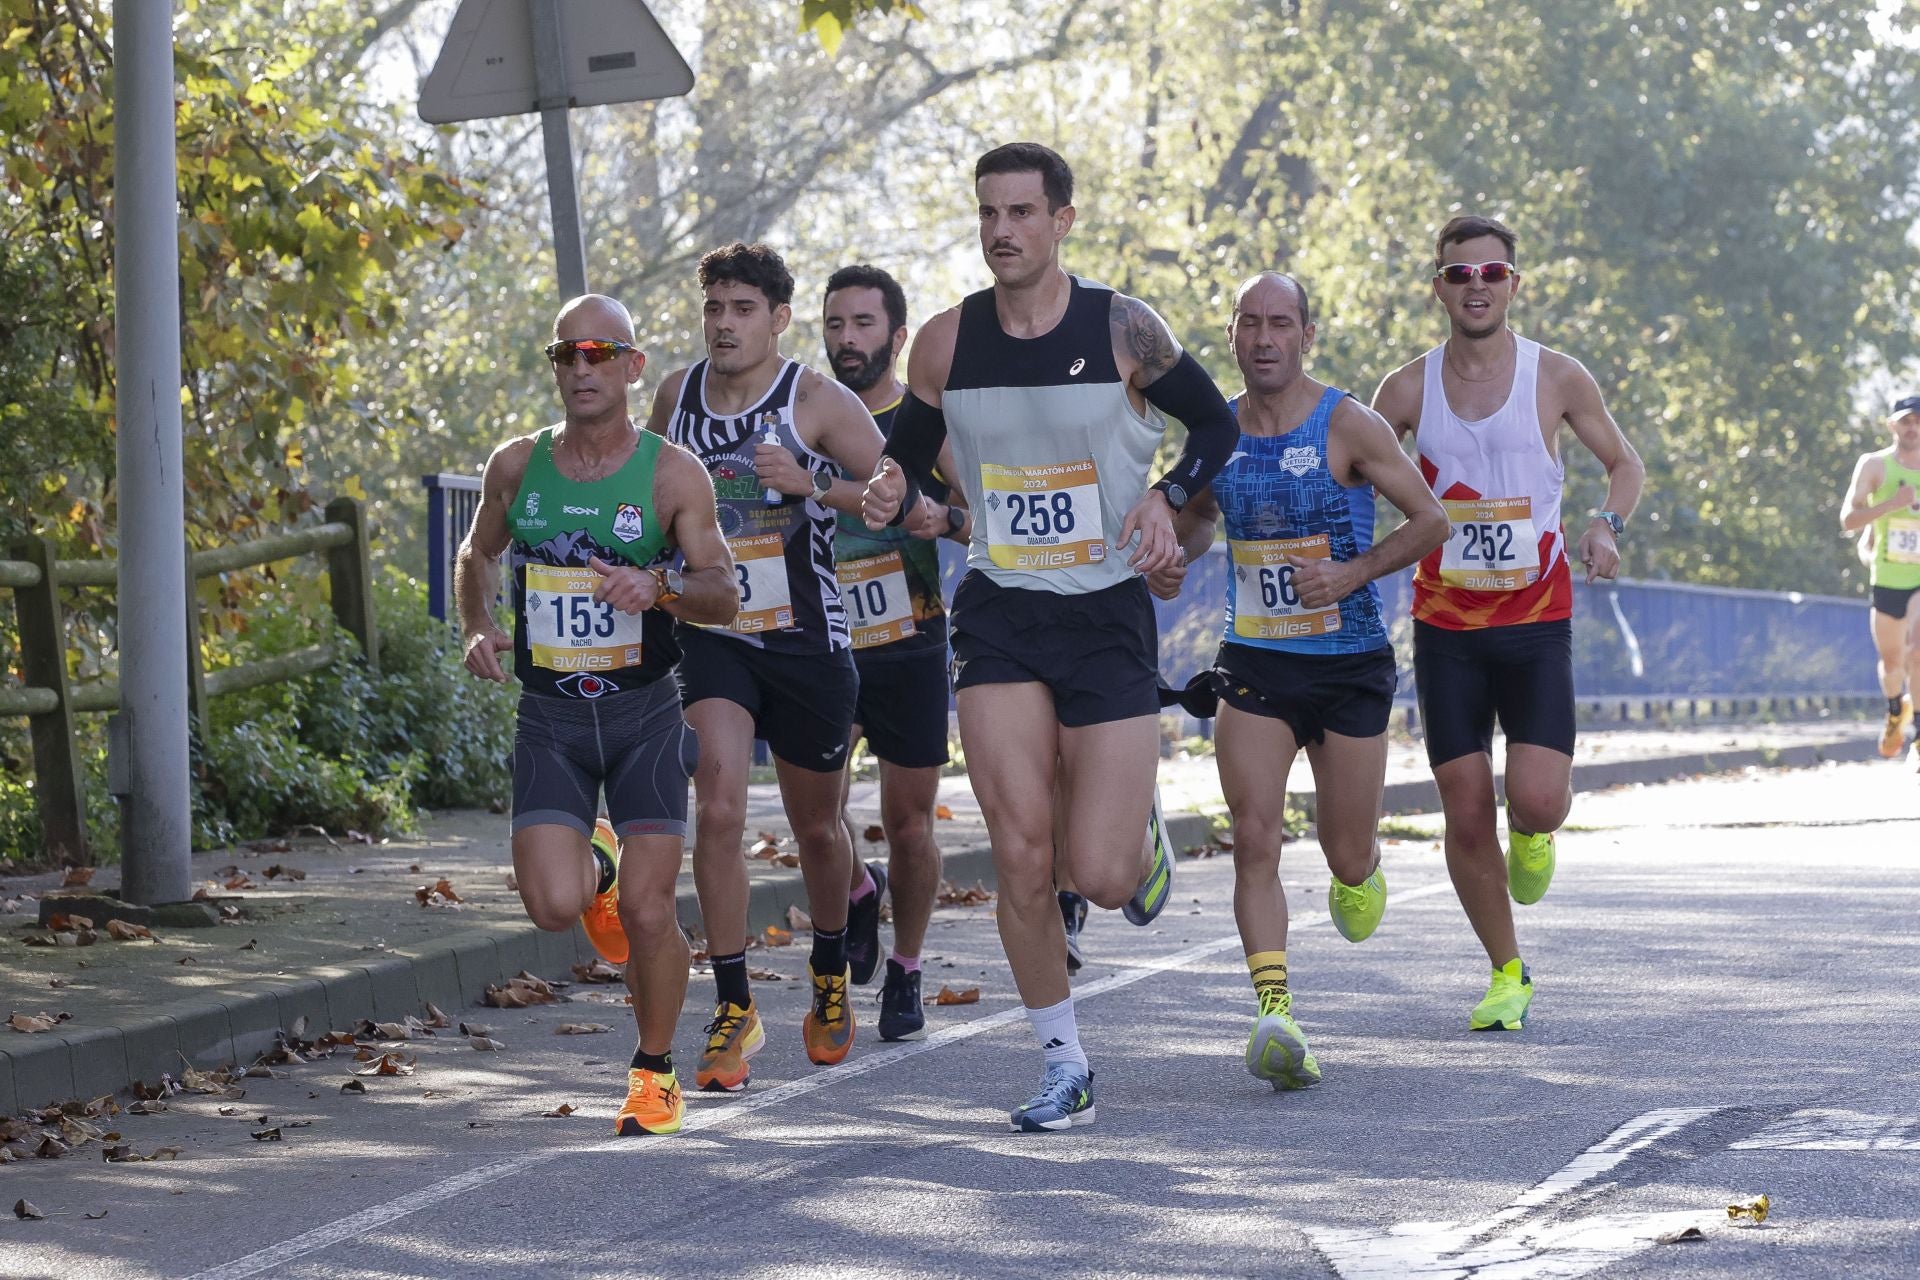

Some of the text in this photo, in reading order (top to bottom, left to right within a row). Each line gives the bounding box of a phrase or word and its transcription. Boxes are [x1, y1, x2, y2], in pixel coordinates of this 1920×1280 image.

[703, 452, 758, 471] STAURANTE
[1284, 458, 1315, 466] VETUSTA
[1025, 466, 1065, 477] MARATÓN
[1065, 461, 1093, 473] AVILÉS
[1023, 480, 1047, 488] 2024
[1006, 492, 1075, 536] 258
[1475, 511, 1495, 519] 2024
[754, 535, 779, 546] AVILÉS
[1027, 536, 1060, 545] GUARDADO
[1263, 541, 1300, 552] MARATÓN
[1301, 537, 1326, 549] AVILÉS
[1462, 523, 1516, 561] 252
[1261, 553, 1285, 563] 2024
[841, 571, 862, 582] 2024
[567, 581, 593, 590] 2024
[734, 563, 752, 603] 3
[1259, 565, 1300, 609] 66
[847, 580, 888, 620] 10
[550, 595, 615, 638] 153
[1270, 607, 1292, 617] TONINO
[570, 639, 593, 647] NACHO
